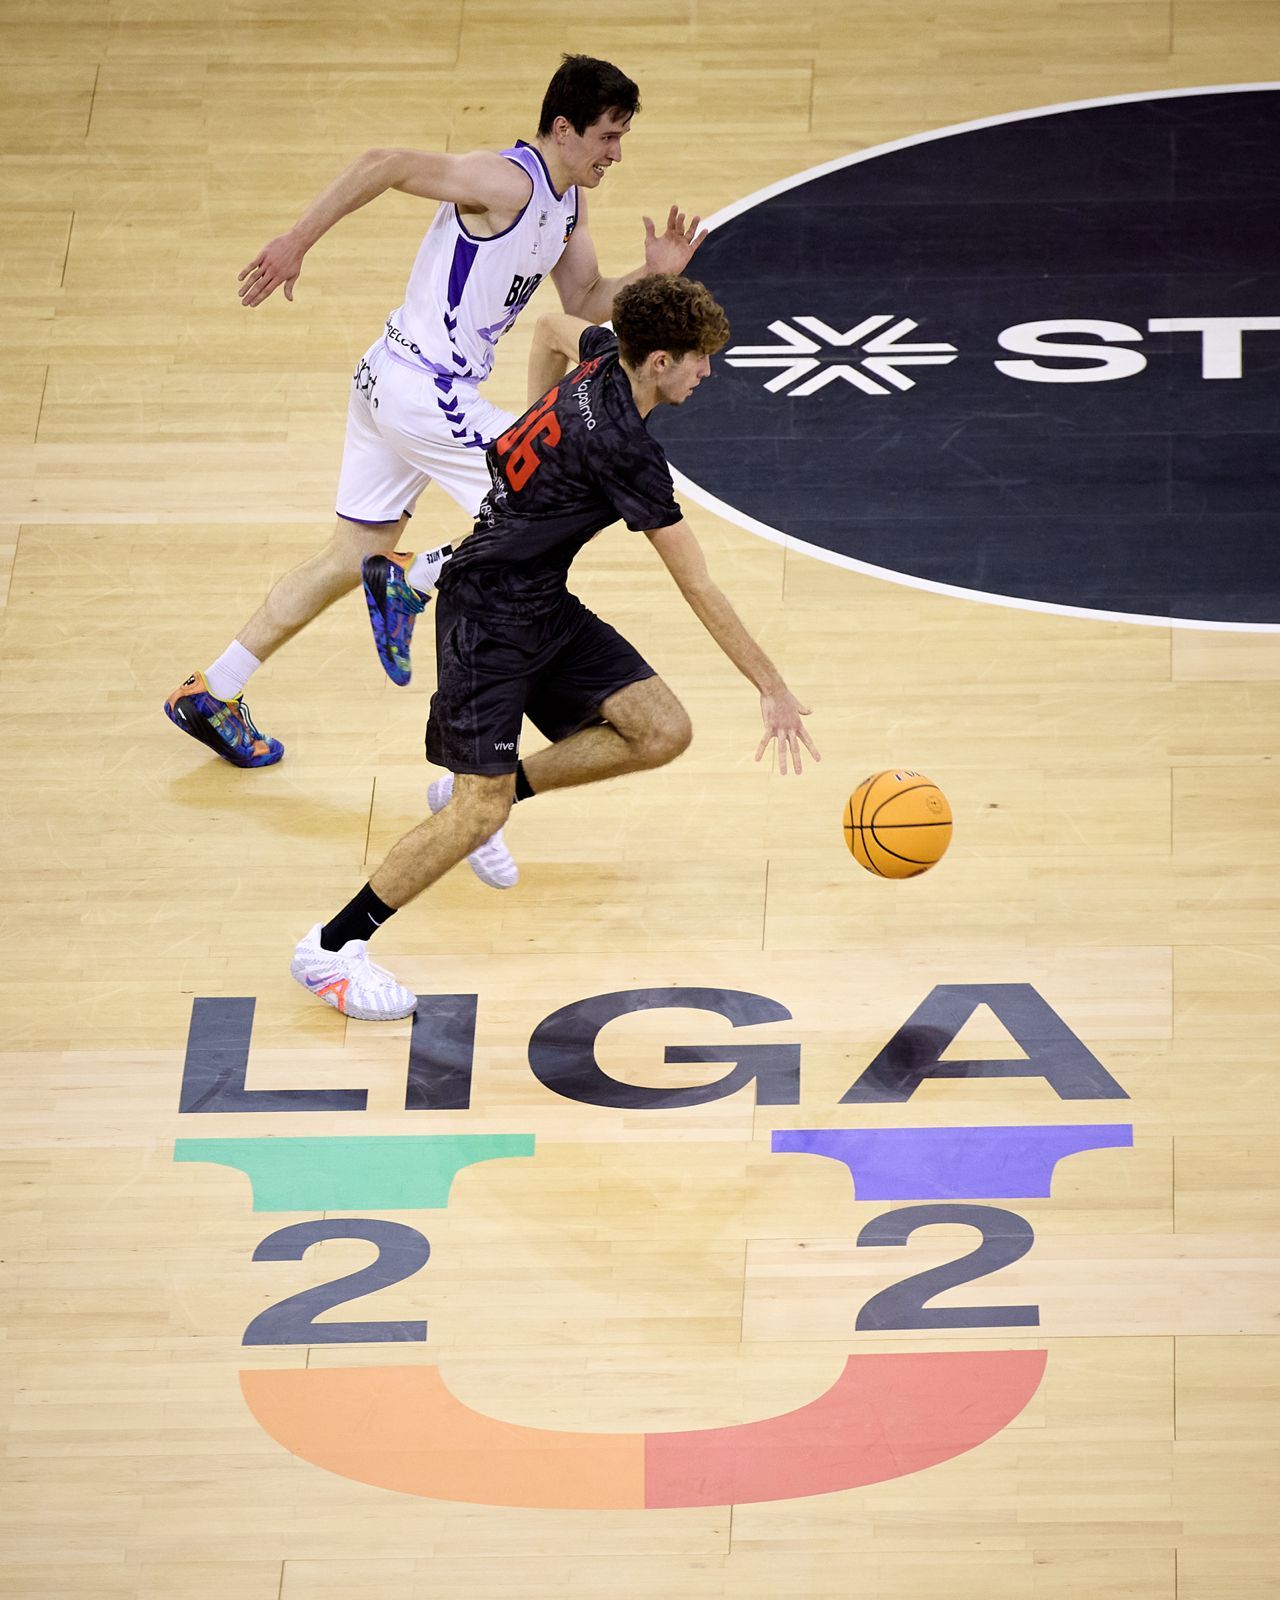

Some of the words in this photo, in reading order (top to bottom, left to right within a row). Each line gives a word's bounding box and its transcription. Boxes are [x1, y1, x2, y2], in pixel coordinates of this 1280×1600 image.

[994, 316, 1280, 384] ST
[494, 741, 515, 751] vive
[179, 983, 1132, 1114] LIGA
